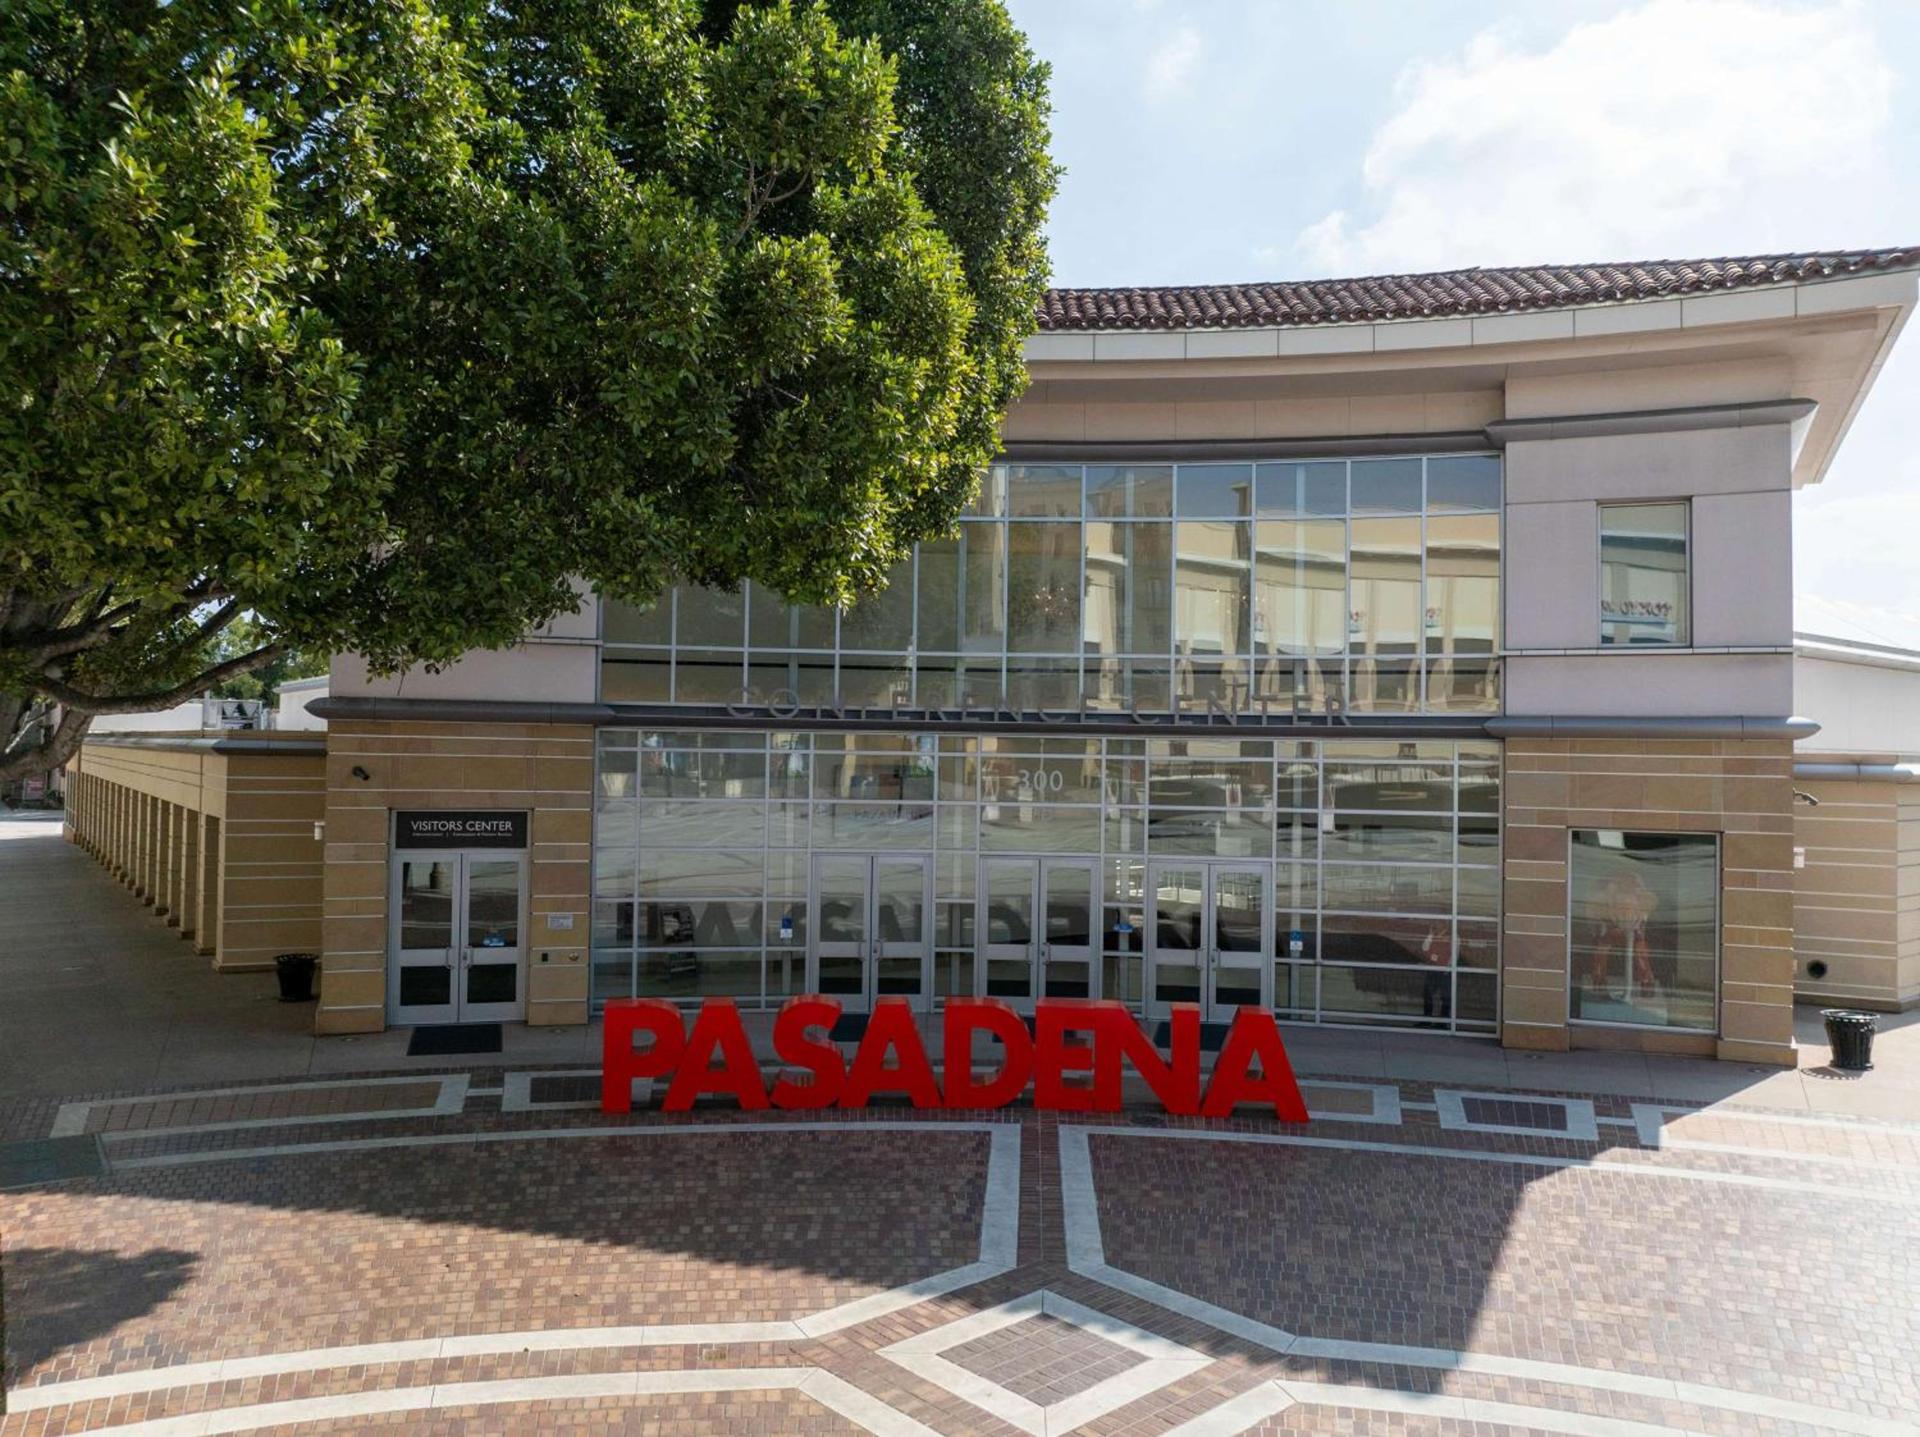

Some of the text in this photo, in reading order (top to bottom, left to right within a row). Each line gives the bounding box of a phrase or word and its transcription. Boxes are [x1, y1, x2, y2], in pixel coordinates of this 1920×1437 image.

[727, 687, 1352, 726] CONFERENCE CENTER
[1018, 769, 1063, 792] 300
[411, 820, 512, 831] VISITORS CENTER
[602, 995, 1309, 1122] PASADENA
